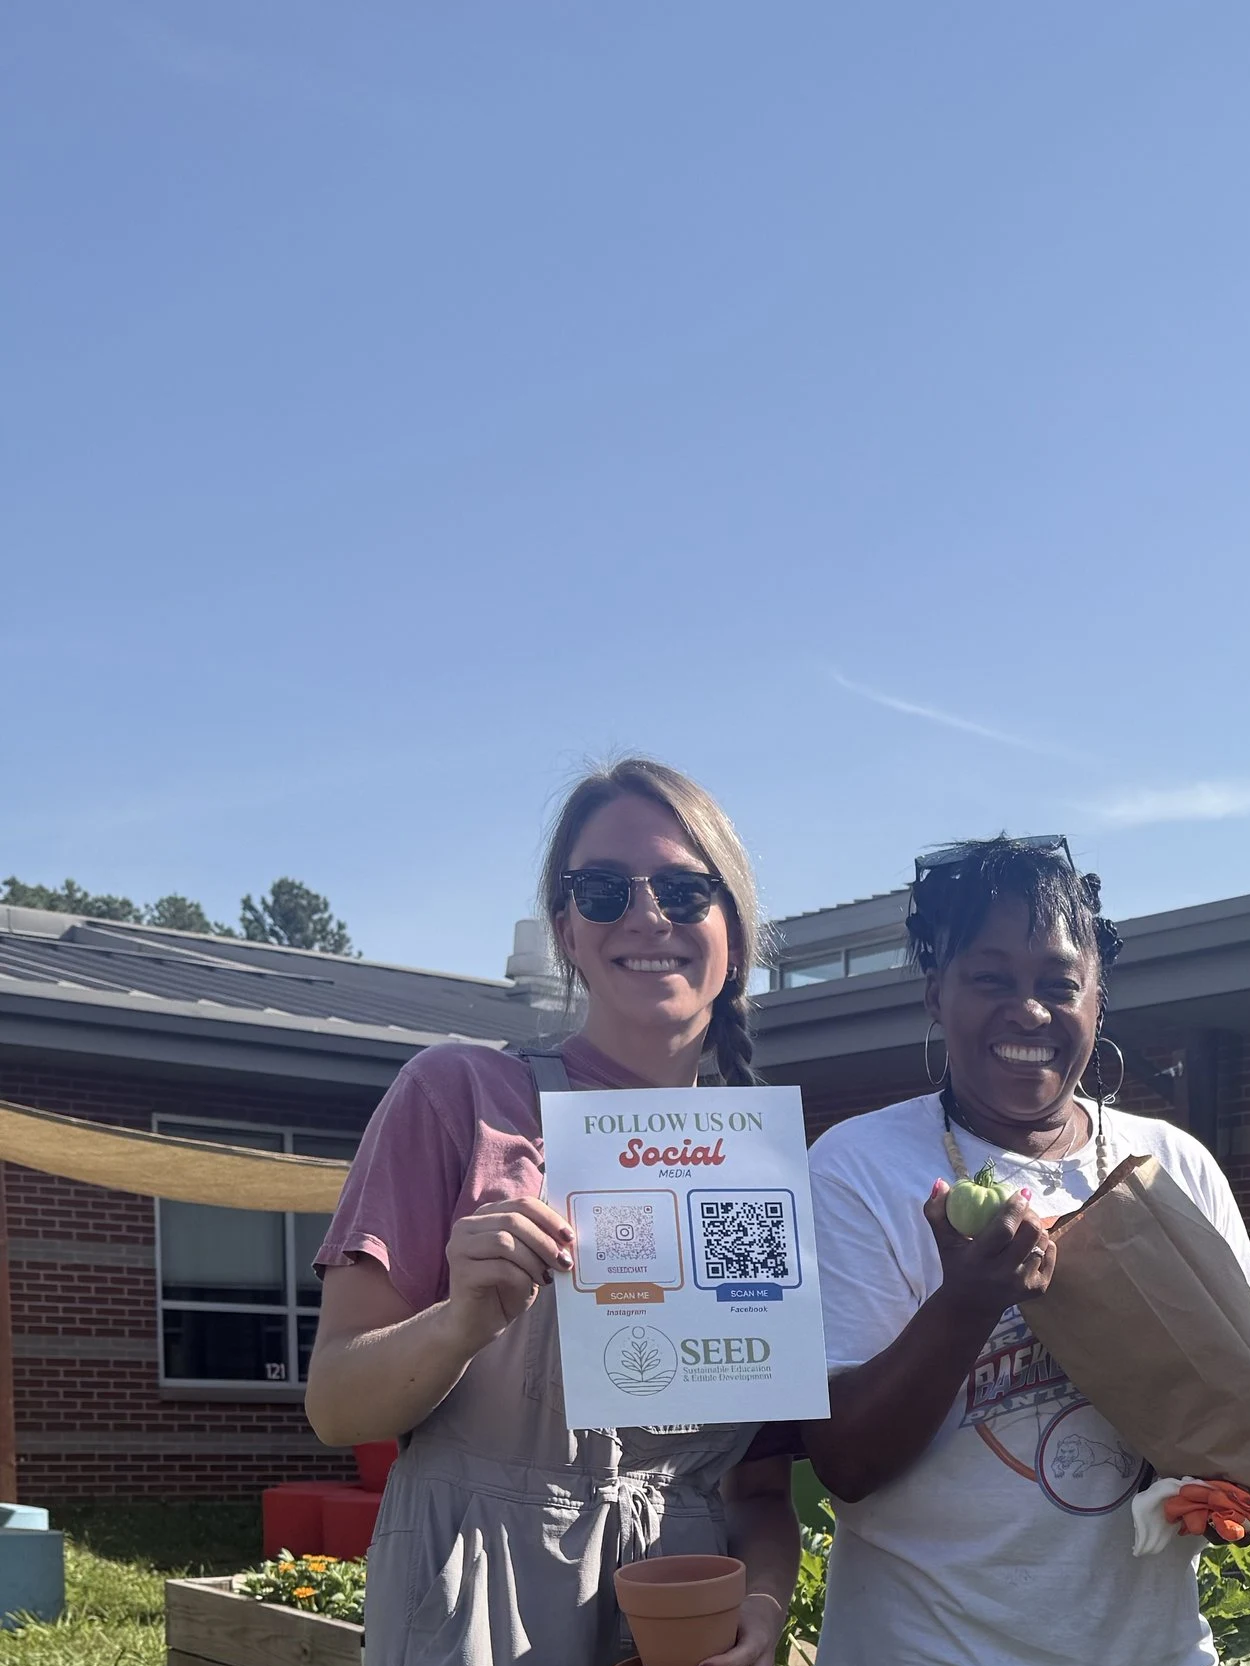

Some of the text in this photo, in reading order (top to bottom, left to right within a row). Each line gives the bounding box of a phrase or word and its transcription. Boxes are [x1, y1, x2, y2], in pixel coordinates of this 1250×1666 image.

[584, 1112, 763, 1134] FOLLOW US ON
[619, 1138, 725, 1168] Social
[659, 1169, 691, 1178] MEDIA
[611, 1292, 635, 1300] SCAN
[731, 1290, 755, 1298] SCAN
[607, 1308, 646, 1317] Instagram
[681, 1338, 770, 1365] SEED
[265, 1362, 286, 1380] 121
